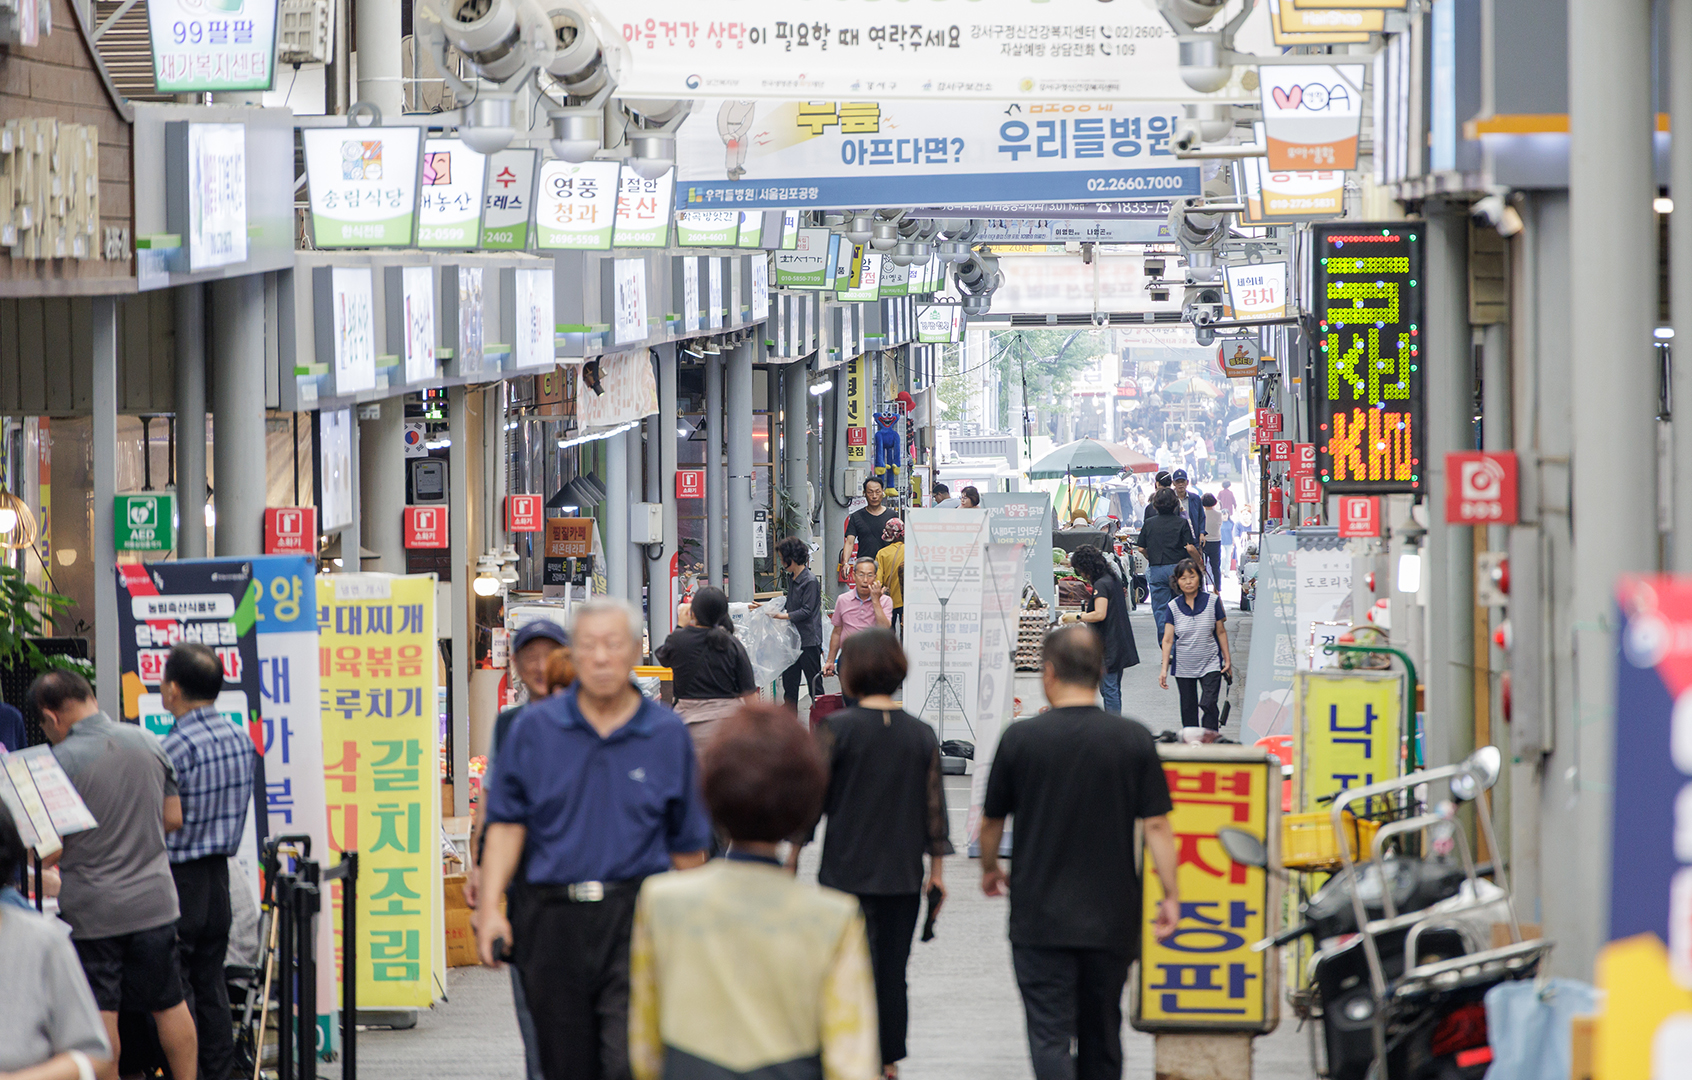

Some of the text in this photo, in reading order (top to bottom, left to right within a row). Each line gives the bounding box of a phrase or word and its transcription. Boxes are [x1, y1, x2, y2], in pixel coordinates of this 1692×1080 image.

[623, 18, 961, 52] 마음건강 상담이 필요할 때 연락주세요
[971, 25, 1095, 40] 강서구정신건강복지센터
[1000, 43, 1135, 57] 자살예방 상담전화 109
[159, 52, 267, 82] 재가복지센터
[998, 115, 1178, 162] 우리들병원
[841, 137, 965, 166] 아프다면?
[496, 166, 516, 188] 수
[619, 178, 658, 193] 절한
[1087, 175, 1183, 192] 02.2660.7000
[554, 178, 598, 198] 영풍
[321, 187, 404, 209] 송림식당
[554, 203, 599, 223] 청과
[549, 234, 600, 244] 2696-5598
[614, 233, 656, 242] 604-0467
[688, 234, 727, 242] 2604-4601
[1241, 287, 1274, 306] 김치
[1459, 503, 1502, 519] SOS
[130, 529, 155, 540] AED
[415, 532, 436, 541] 소화기
[369, 738, 423, 982] 갈치조림
